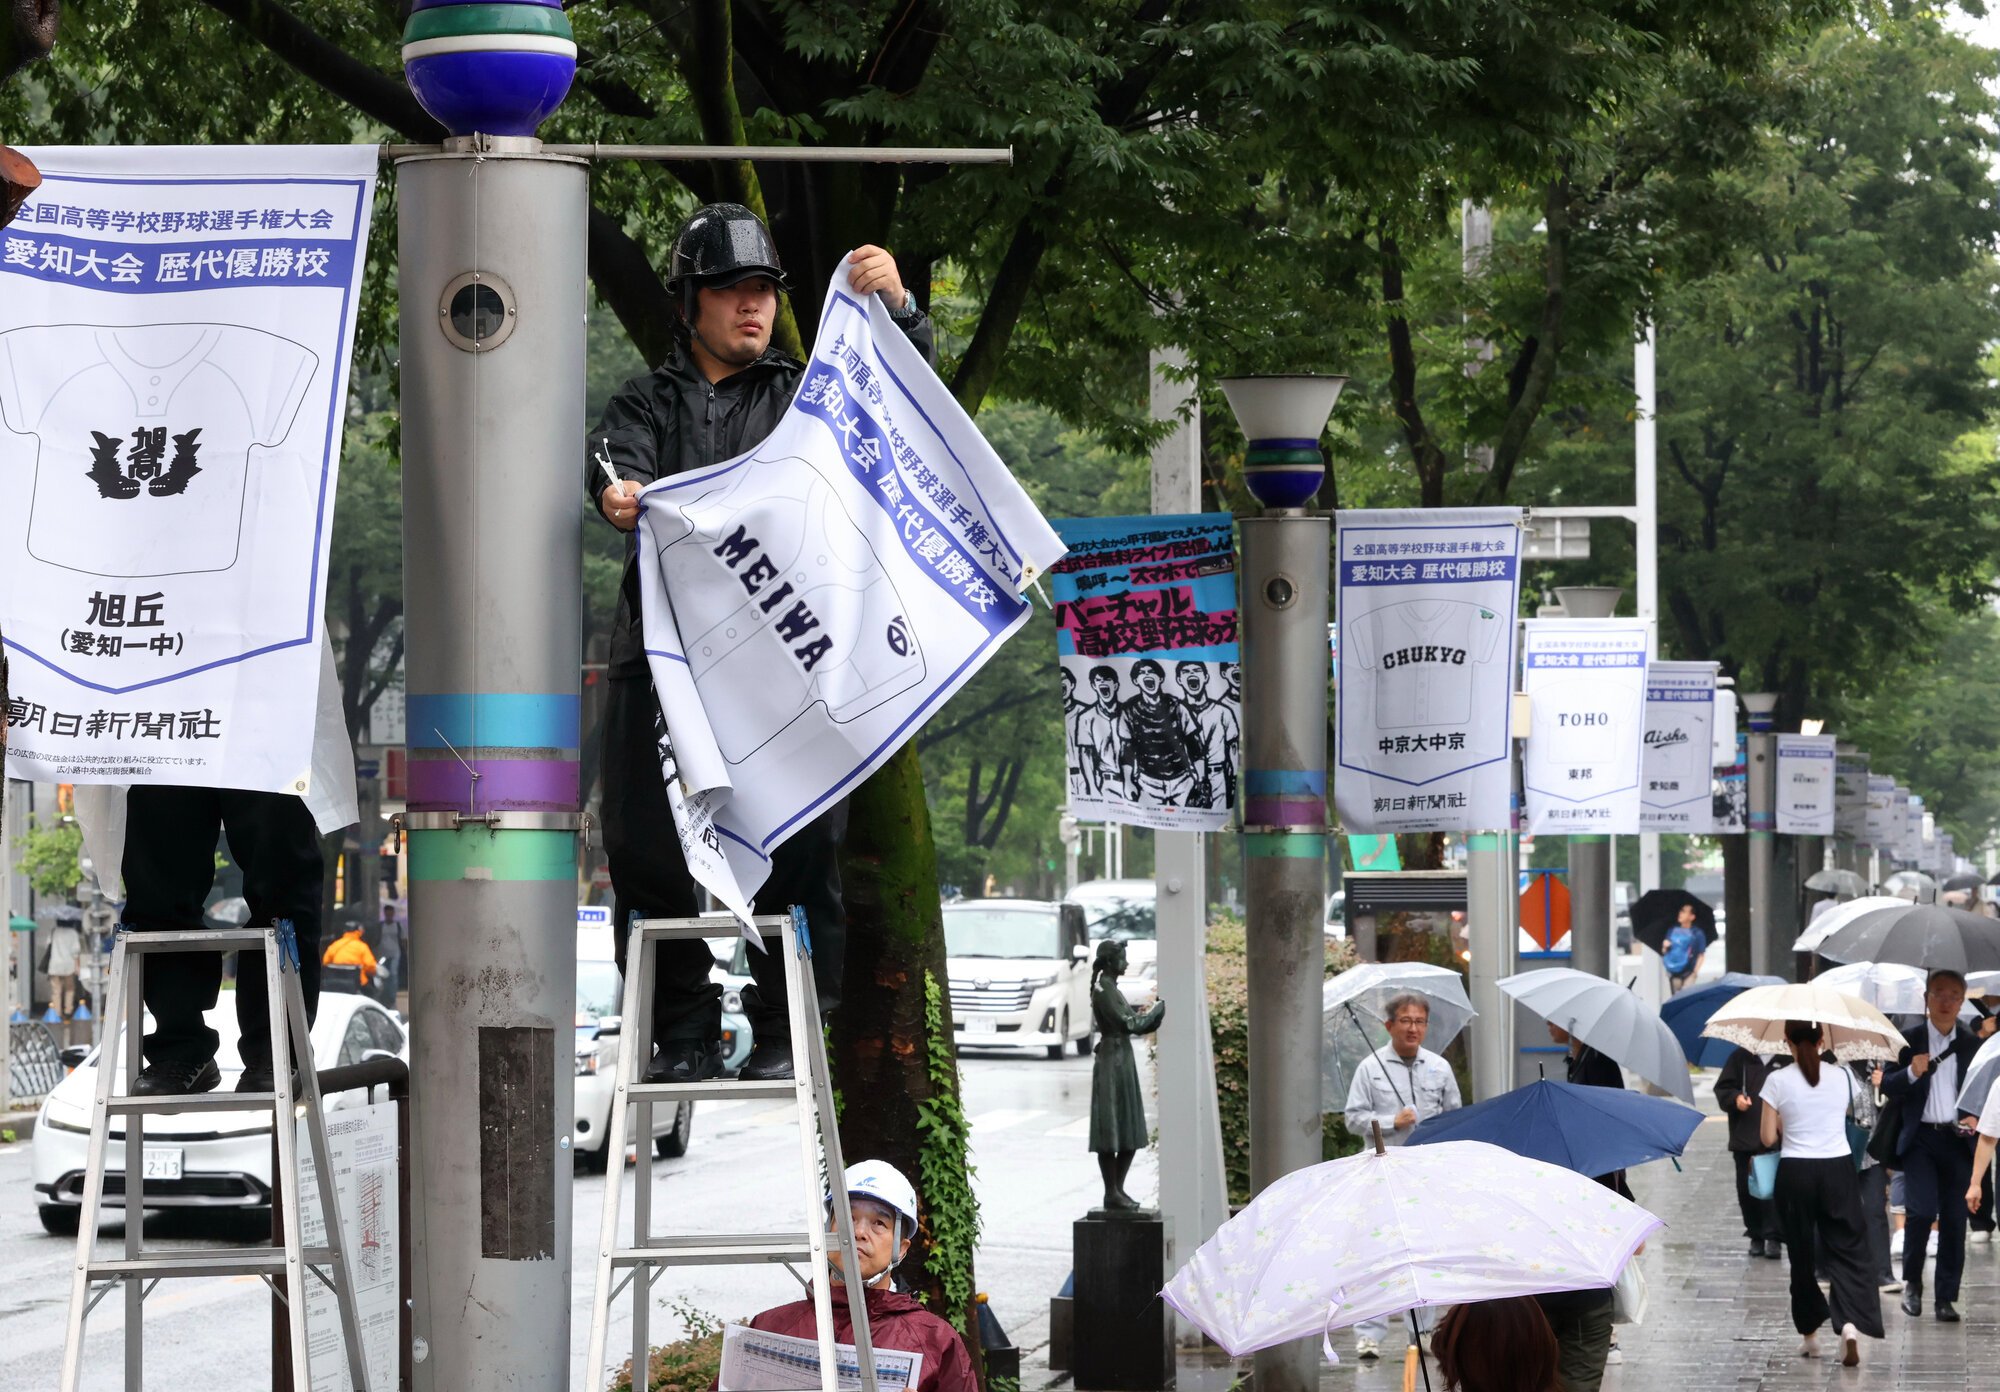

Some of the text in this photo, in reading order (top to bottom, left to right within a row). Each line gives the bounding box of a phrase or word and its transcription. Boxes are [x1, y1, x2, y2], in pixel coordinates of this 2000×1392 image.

[16, 201, 334, 234] 全国高等学校野球選手権大会
[3, 236, 331, 285] 愛知大会 歴代優勝校
[801, 373, 999, 613] 愛知大会 歴代優勝校
[1352, 540, 1506, 557] 全国高等学校野球選手権大会
[1351, 560, 1506, 582] 愛知大会 歴代優勝校
[86, 591, 165, 628] 旭丘
[713, 523, 834, 674] MEIWA
[1056, 586, 1192, 628] バーチャル
[60, 628, 184, 658] （愛知一中）
[1382, 645, 1467, 670] CHUKYO
[7, 697, 222, 741] 朝日新聞社
[1558, 712, 1608, 727] TOHO
[1378, 732, 1467, 755] 中京大中京
[1568, 768, 1592, 781] 東邦
[1373, 792, 1467, 813] 朝日新聞社
